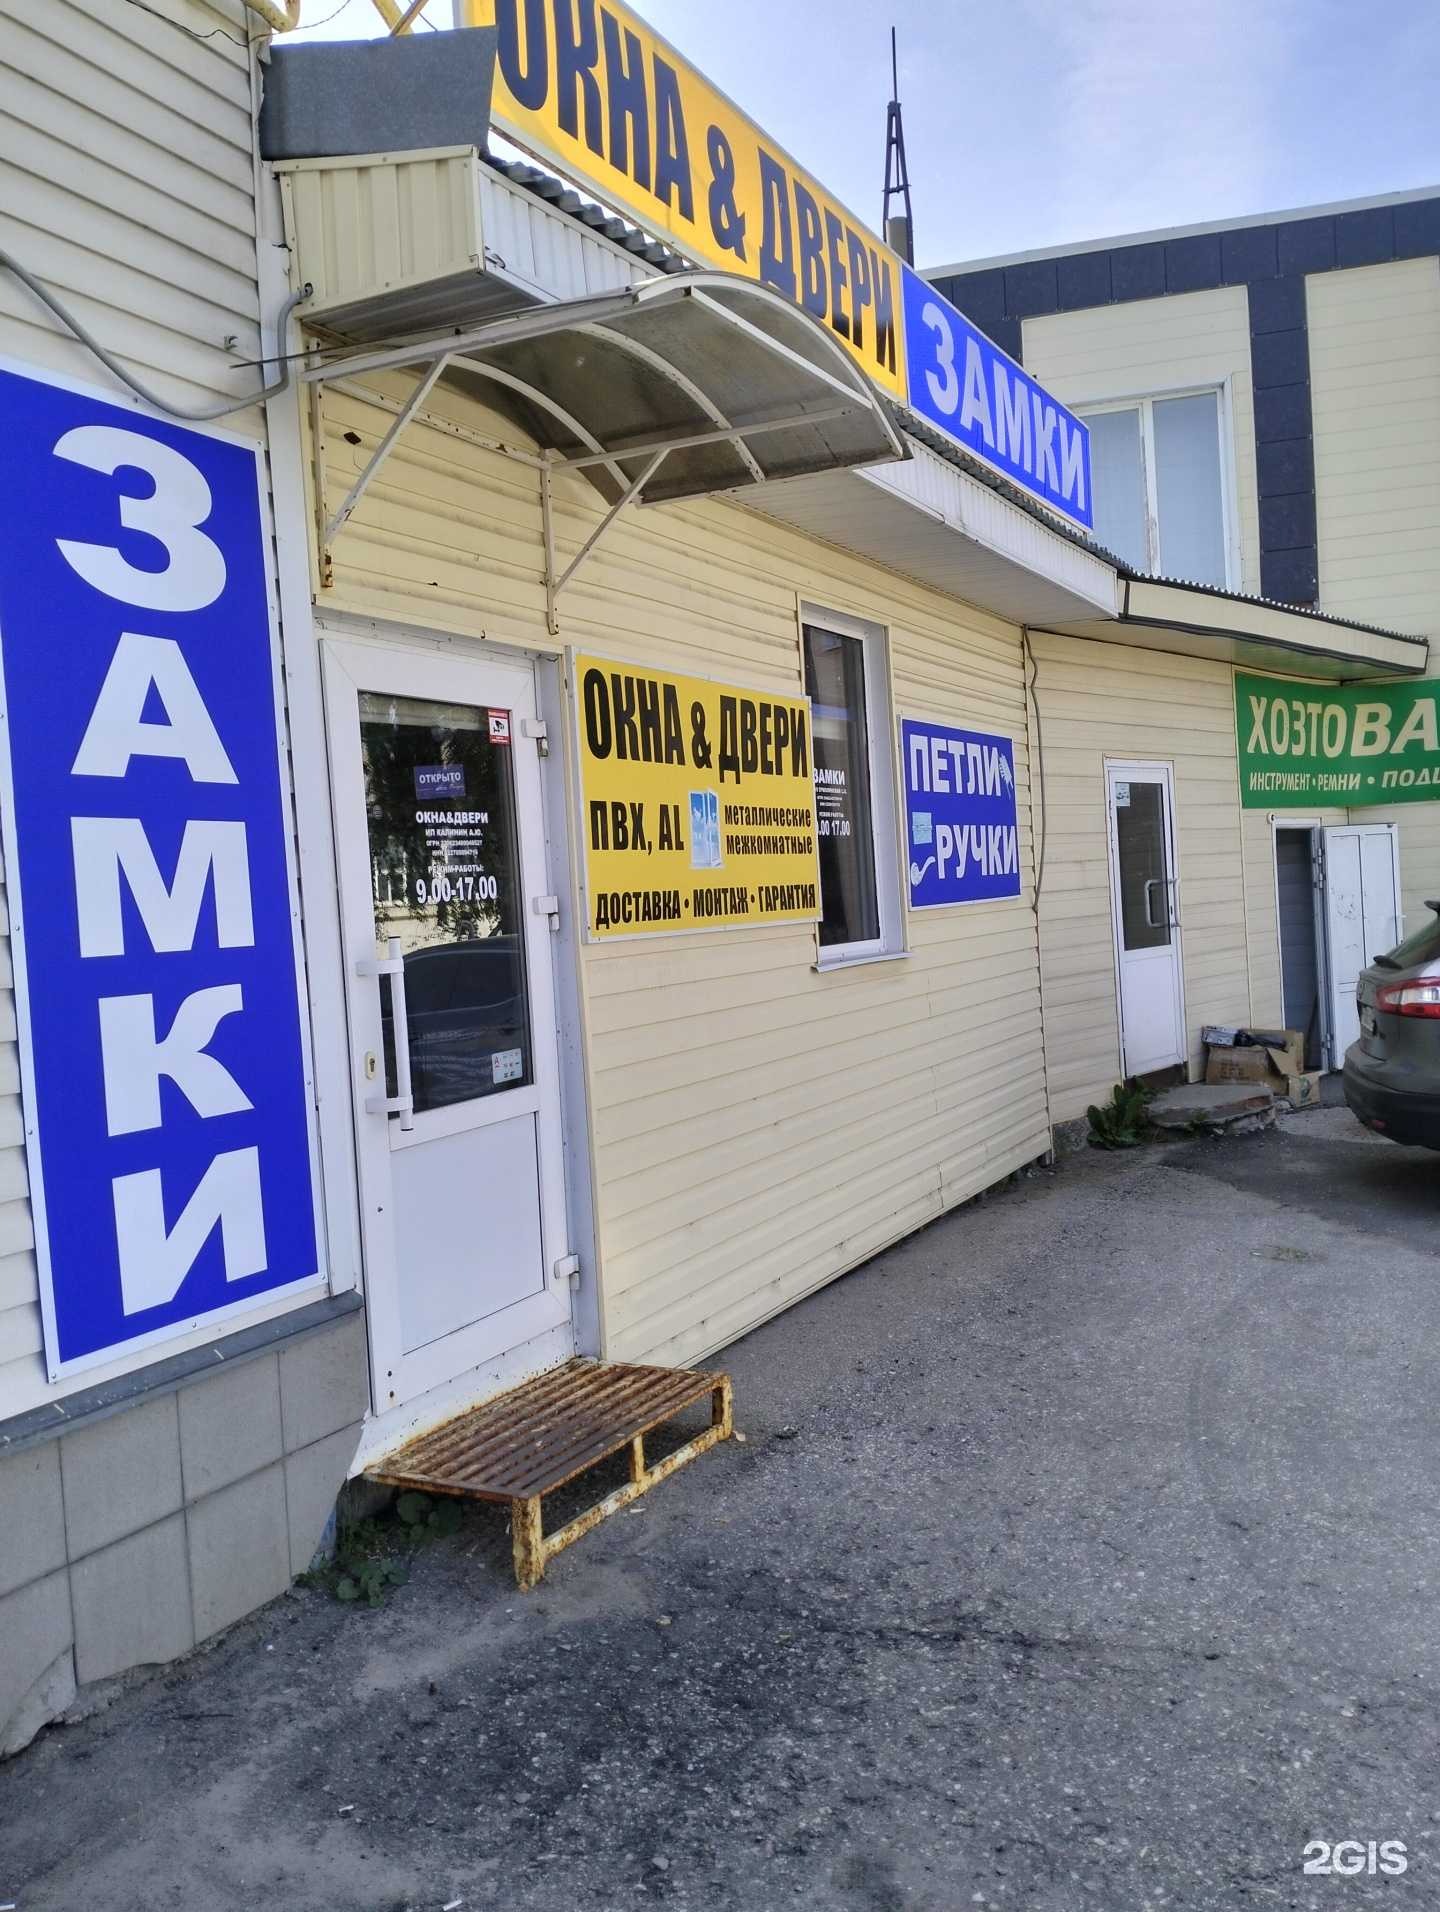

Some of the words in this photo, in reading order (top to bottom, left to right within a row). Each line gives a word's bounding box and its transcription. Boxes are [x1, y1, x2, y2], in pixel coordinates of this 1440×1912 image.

[497, 0, 695, 225] ОКНА
[707, 124, 747, 264] &
[758, 146, 897, 377] ДВЕРИ
[922, 302, 1086, 512] ЗАМКИ
[584, 668, 686, 766] ОКНА
[691, 701, 713, 769] &
[719, 695, 808, 785] ДВЕРИ
[1247, 695, 1440, 758] ХОЗТОВА
[419, 772, 461, 784] ОТКРЫТО
[910, 734, 1001, 796] ПЕТЛИ
[1250, 772, 1311, 791] ИНСТРУМЕНТ
[1318, 773, 1361, 791] РЕМНИ
[415, 811, 489, 826] ОКНА&ДВЕРИ
[590, 800, 653, 856] ПВХ,
[725, 804, 812, 828] металлические
[53, 424, 268, 1317] ЗАМКИ
[727, 834, 813, 856] межкомнатные
[936, 825, 1018, 880] РУЧКИ
[416, 876, 498, 904] 9.00-17.00
[596, 890, 681, 931] ДОСТАВКА
[694, 887, 749, 918] МОНТАЖ
[758, 883, 816, 913] ГАРАНТИЯ
